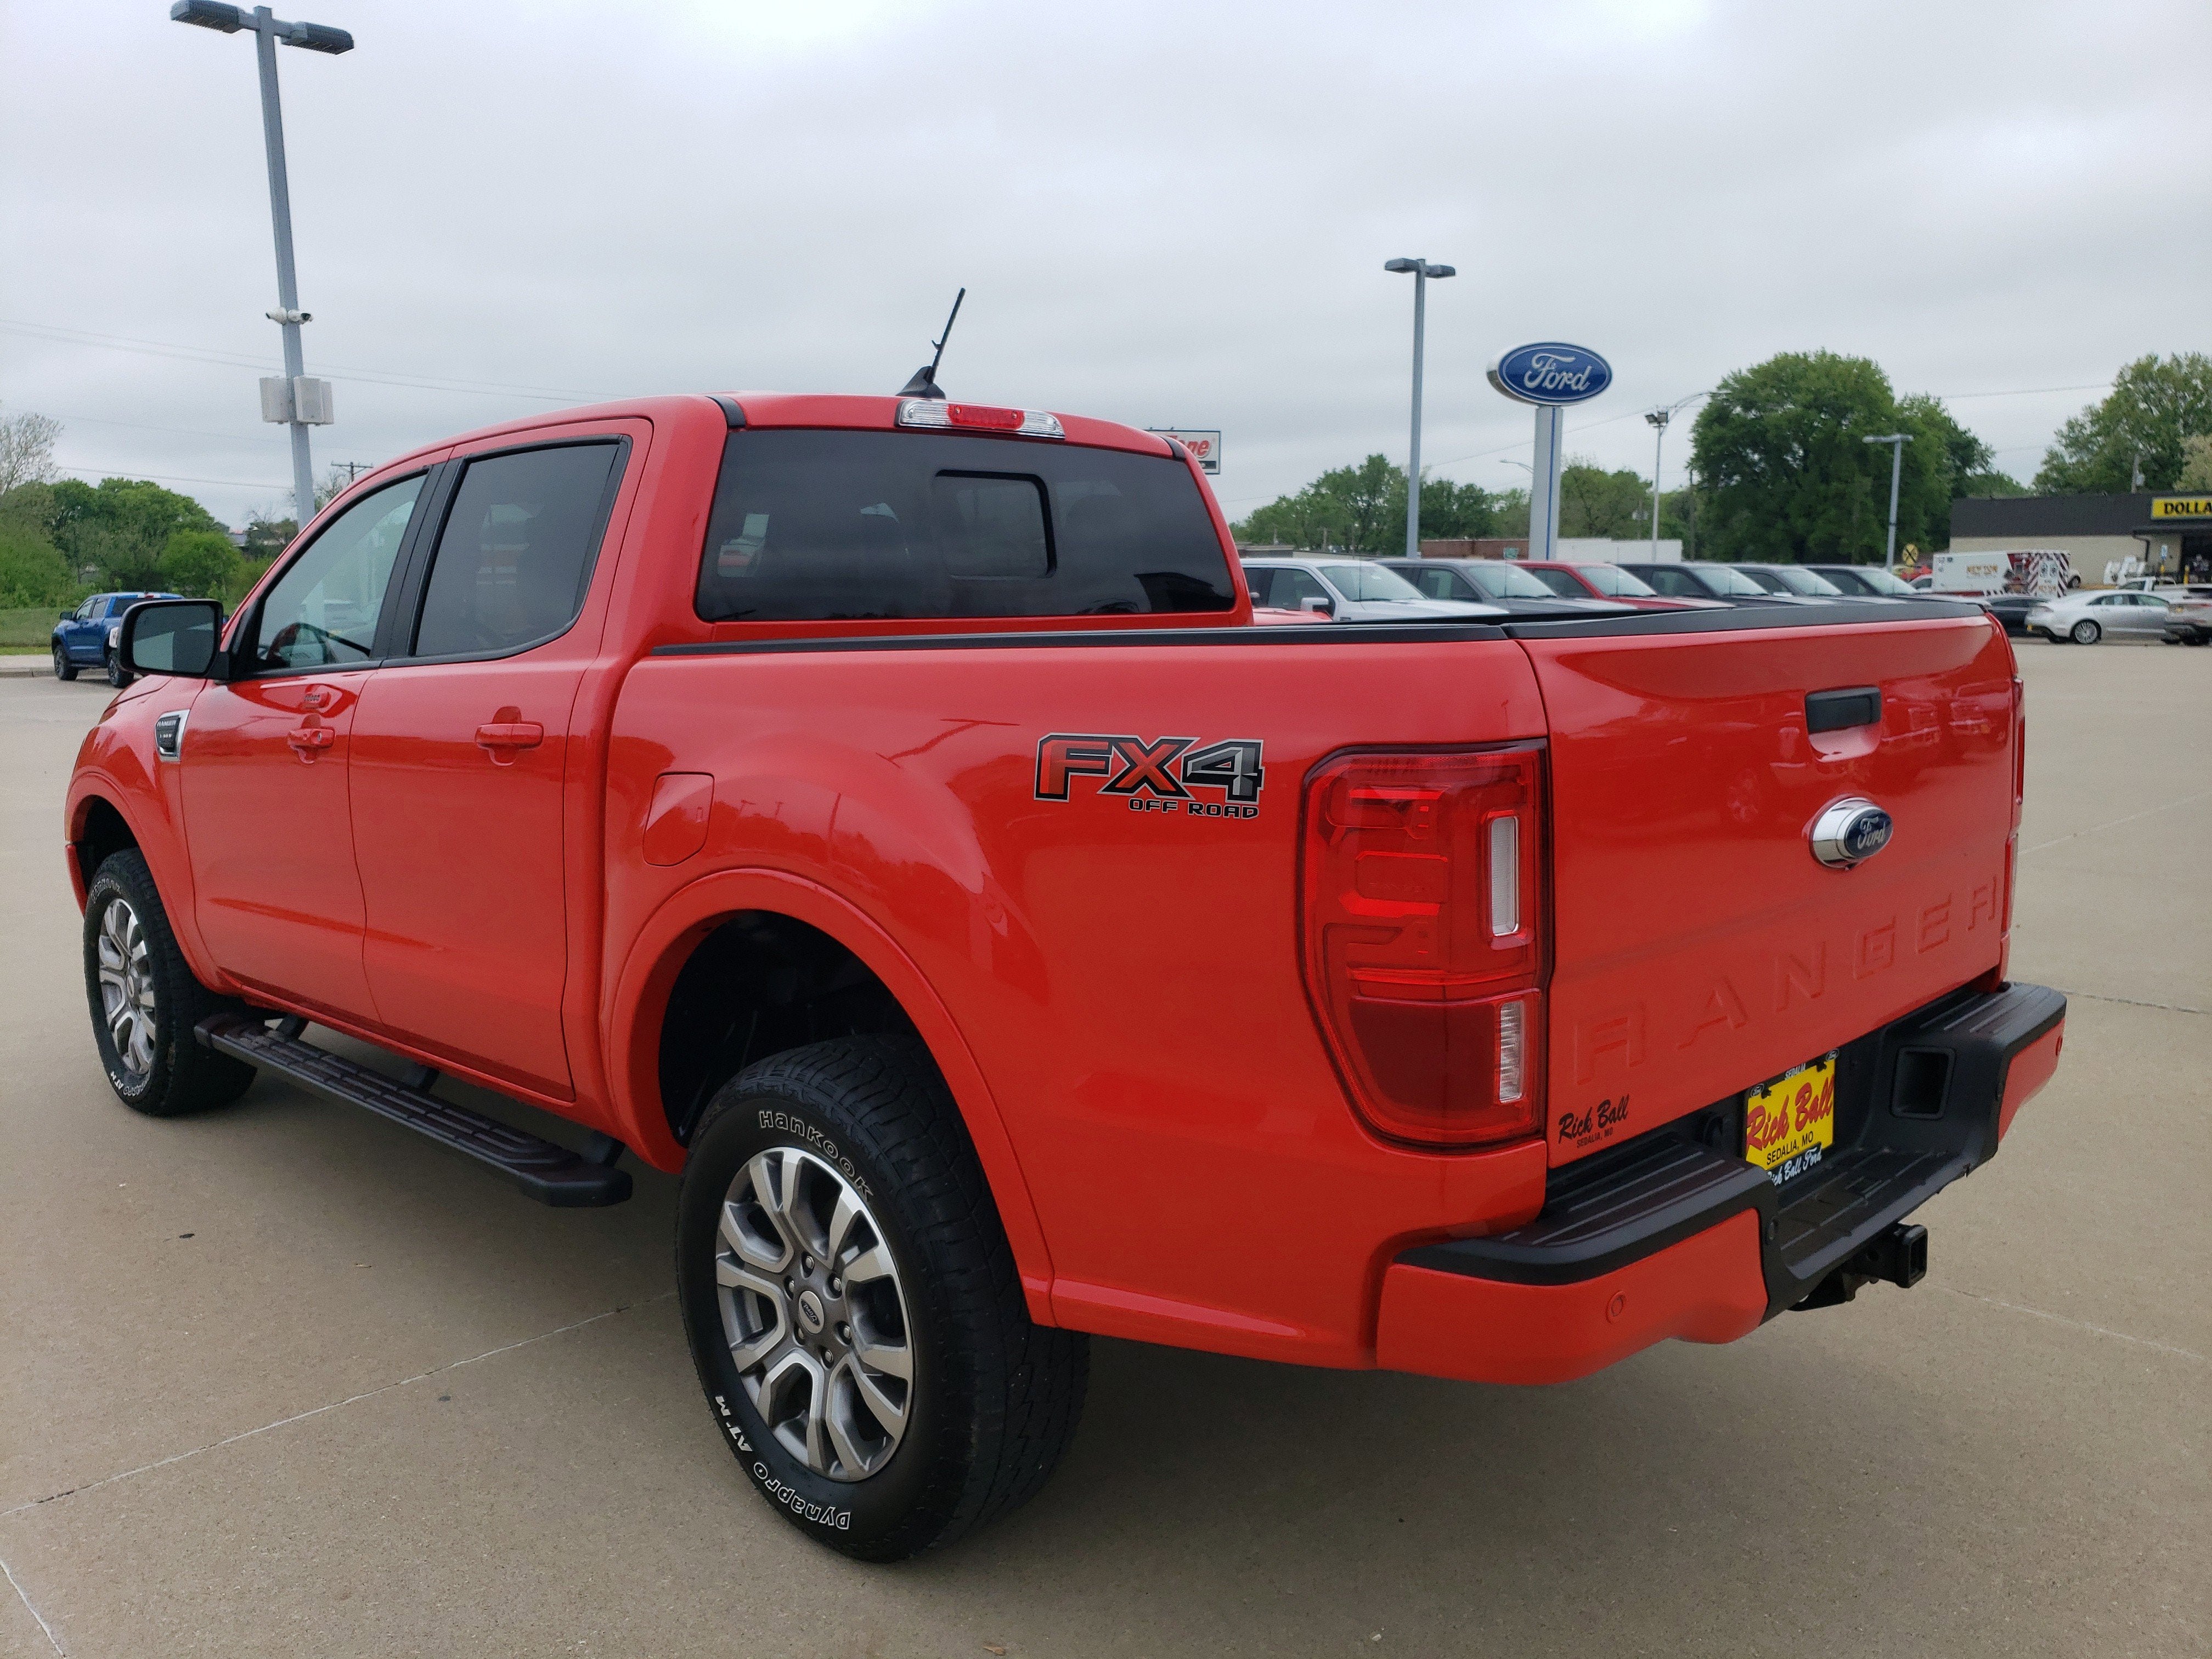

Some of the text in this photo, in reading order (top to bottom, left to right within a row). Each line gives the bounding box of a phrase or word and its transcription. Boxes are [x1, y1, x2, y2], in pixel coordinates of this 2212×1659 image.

[1523, 353, 1592, 391] Ford
[1034, 732, 1265, 804] FX4
[1129, 798, 1259, 820] OFF ROAD
[1857, 816, 1886, 849] Ford
[1573, 874, 1998, 1086] RANGER
[1559, 1093, 1629, 1144] Rick Ball
[1746, 1074, 1834, 1152] Rick Ball
[1604, 1127, 1613, 1138] MO
[1766, 1130, 1814, 1166] SEDALIA, MO
[1784, 1155, 1802, 1181] Ball
[1803, 1144, 1822, 1171] Ford
[753, 1462, 851, 1530] Dynapro
